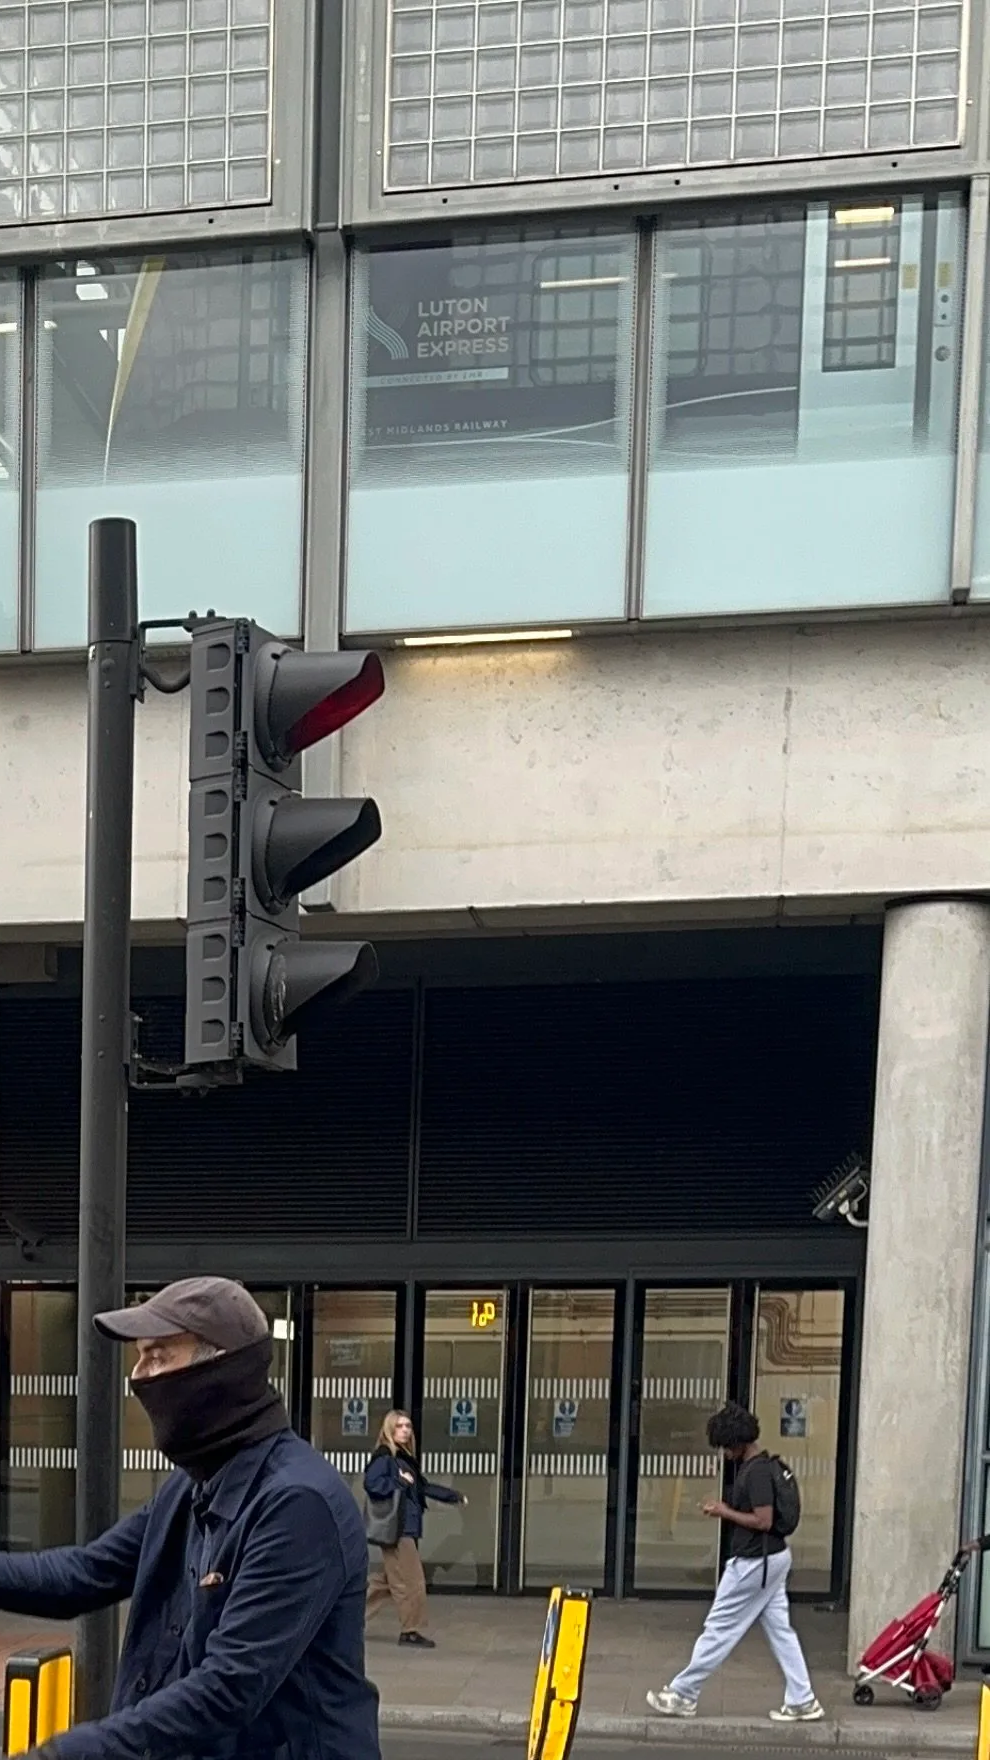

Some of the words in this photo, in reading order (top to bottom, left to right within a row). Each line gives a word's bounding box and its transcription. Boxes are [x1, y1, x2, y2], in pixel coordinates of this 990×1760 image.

[417, 297, 488, 317] LUTON
[417, 316, 511, 338] AIRPORT
[417, 337, 510, 358] EXPRESS
[386, 422, 450, 435] MIDLANDS
[454, 419, 508, 432] RAILWAY
